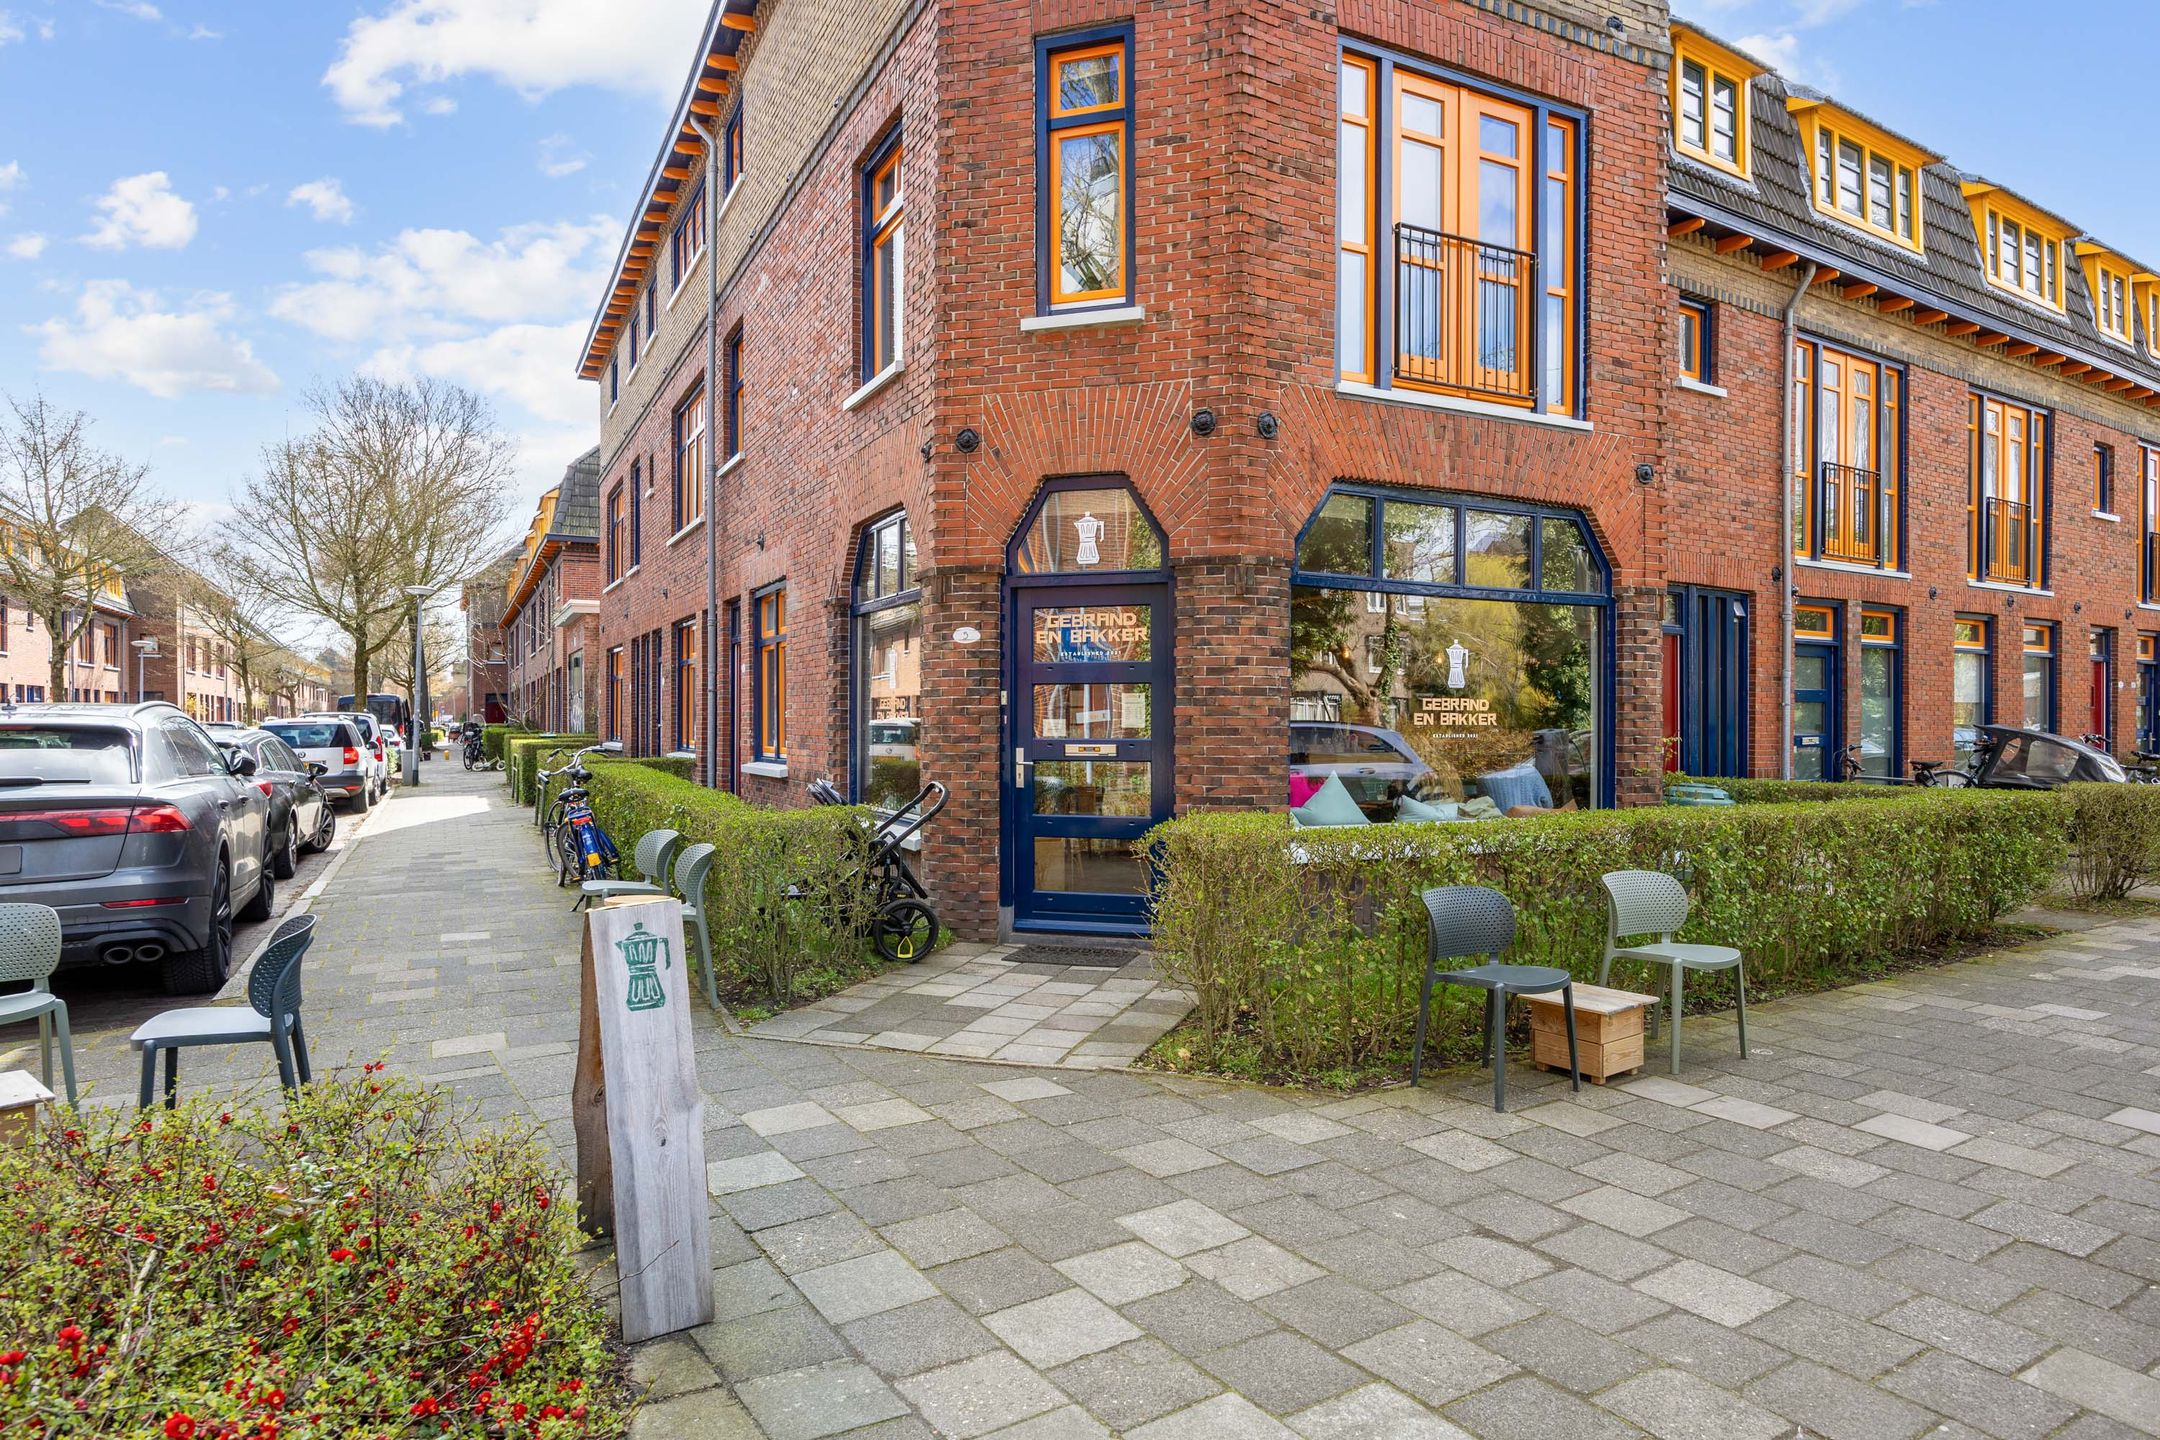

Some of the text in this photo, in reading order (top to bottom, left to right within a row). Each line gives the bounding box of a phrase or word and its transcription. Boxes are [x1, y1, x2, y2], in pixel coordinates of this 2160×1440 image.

[1047, 612, 1137, 628] GEBRAND
[1036, 625, 1149, 643] EN BAKKER
[1422, 697, 1490, 711] GEBRAND
[1413, 712, 1498, 726] EN BAKKER
